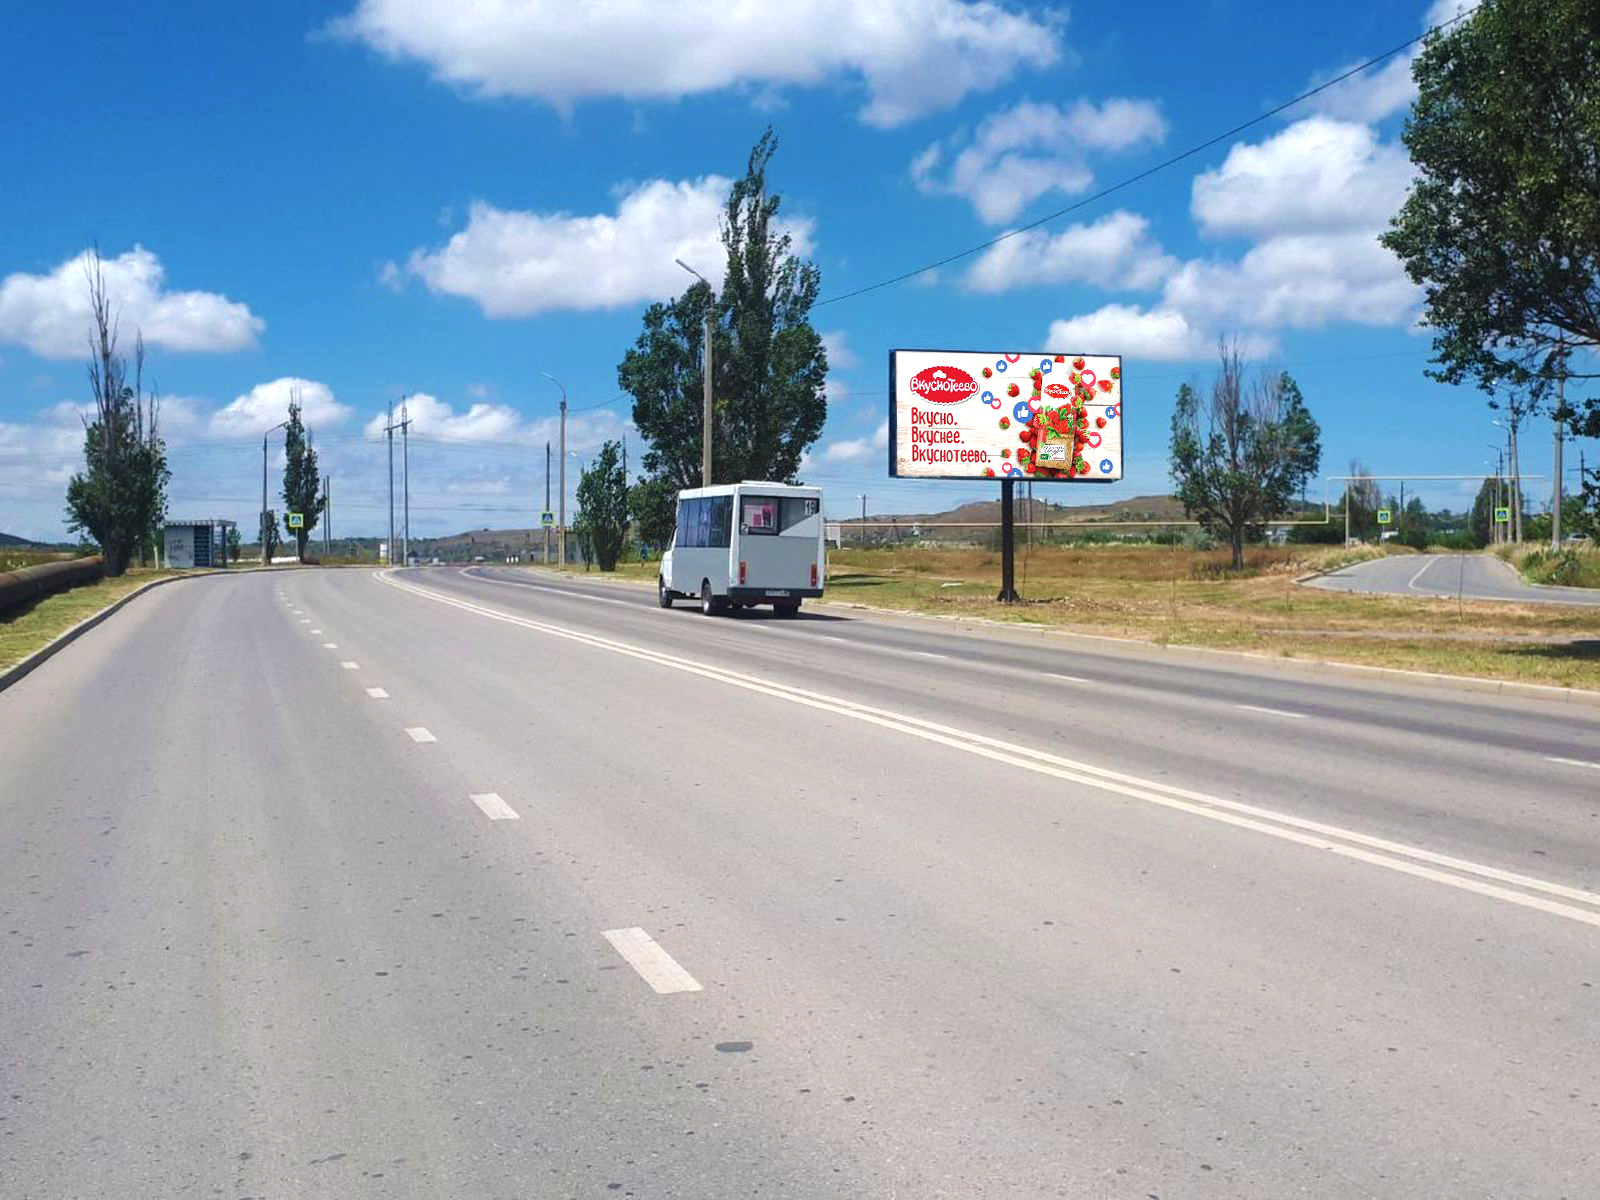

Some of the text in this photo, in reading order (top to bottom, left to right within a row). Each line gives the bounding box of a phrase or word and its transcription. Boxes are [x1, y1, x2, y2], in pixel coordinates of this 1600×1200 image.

[911, 407, 958, 427] Вкусно.
[911, 426, 965, 446] Вкуснее.
[912, 444, 991, 465] Вкуснотеево.
